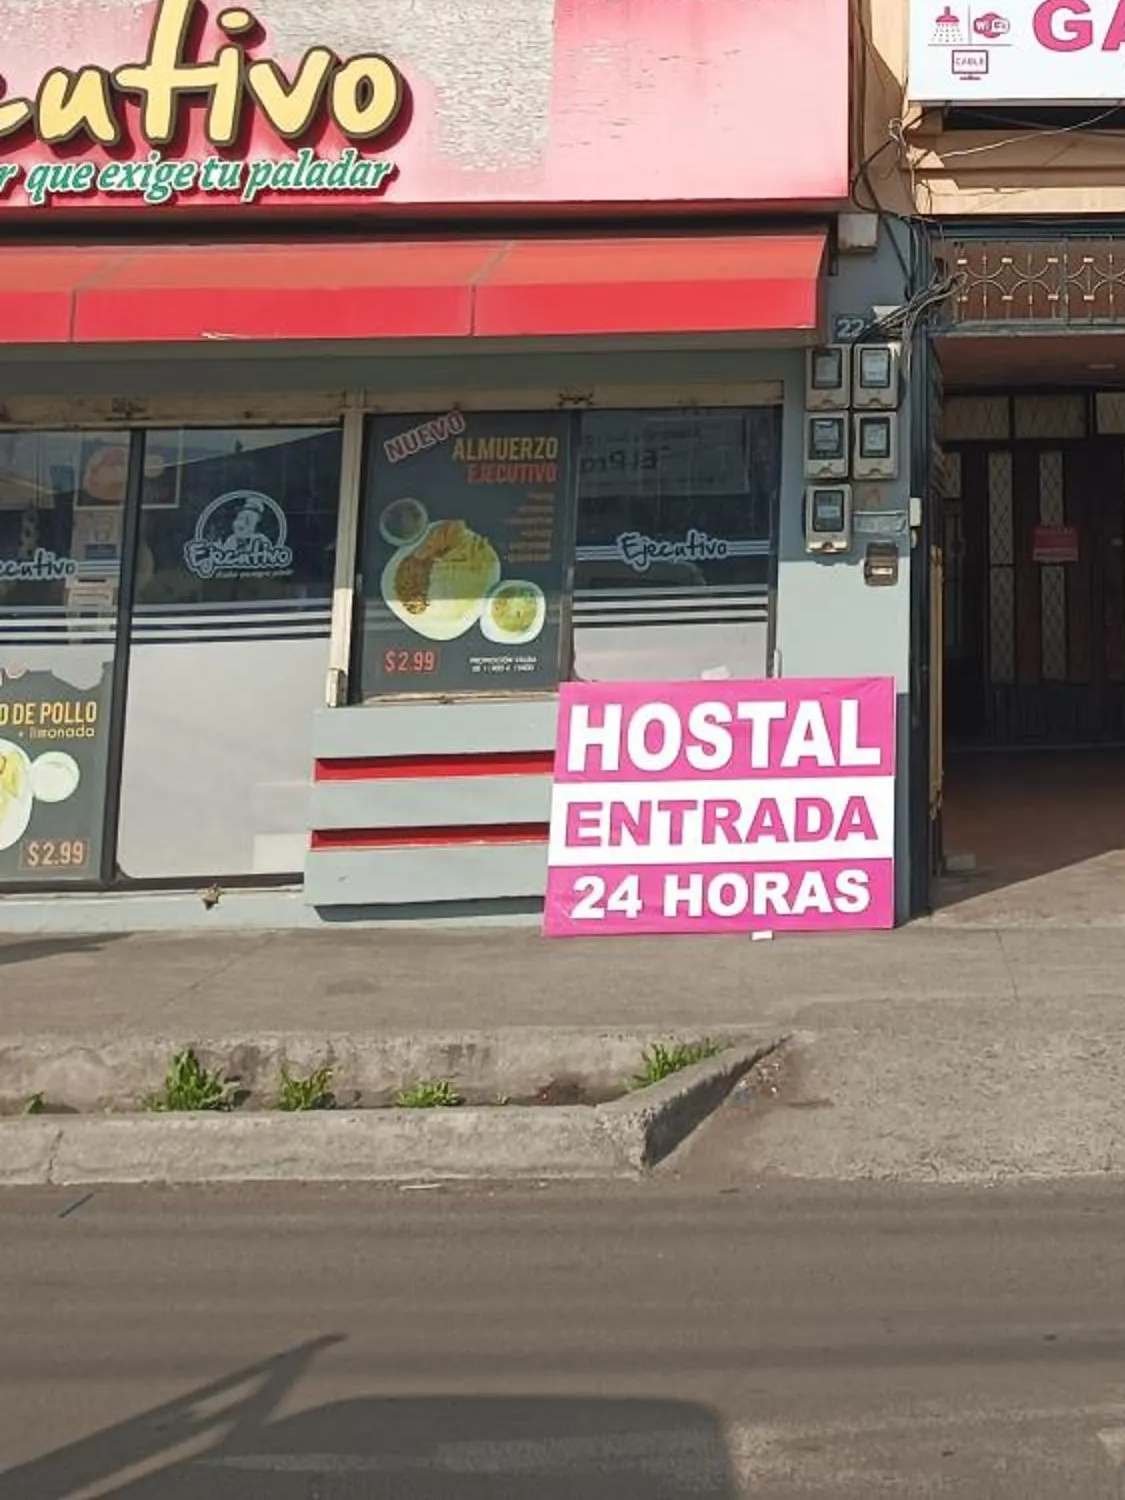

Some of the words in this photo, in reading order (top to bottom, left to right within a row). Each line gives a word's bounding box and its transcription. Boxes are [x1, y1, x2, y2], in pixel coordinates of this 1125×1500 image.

[26, 159, 90, 205] que
[97, 151, 198, 203] exige
[199, 155, 240, 189] tu
[242, 147, 393, 203] paladar
[384, 409, 466, 464] NUEVO
[453, 437, 558, 461] ALMUERZO
[467, 462, 558, 484] EJECUTIVO
[621, 530, 729, 568] Ejecutivo
[13, 702, 36, 725] DE
[39, 701, 97, 725] POLLO
[567, 698, 881, 772] HOSTAL
[564, 795, 879, 848] ENTRADA
[27, 839, 85, 866] $2.99
[568, 874, 643, 919] 24
[662, 868, 870, 918] HORAS
